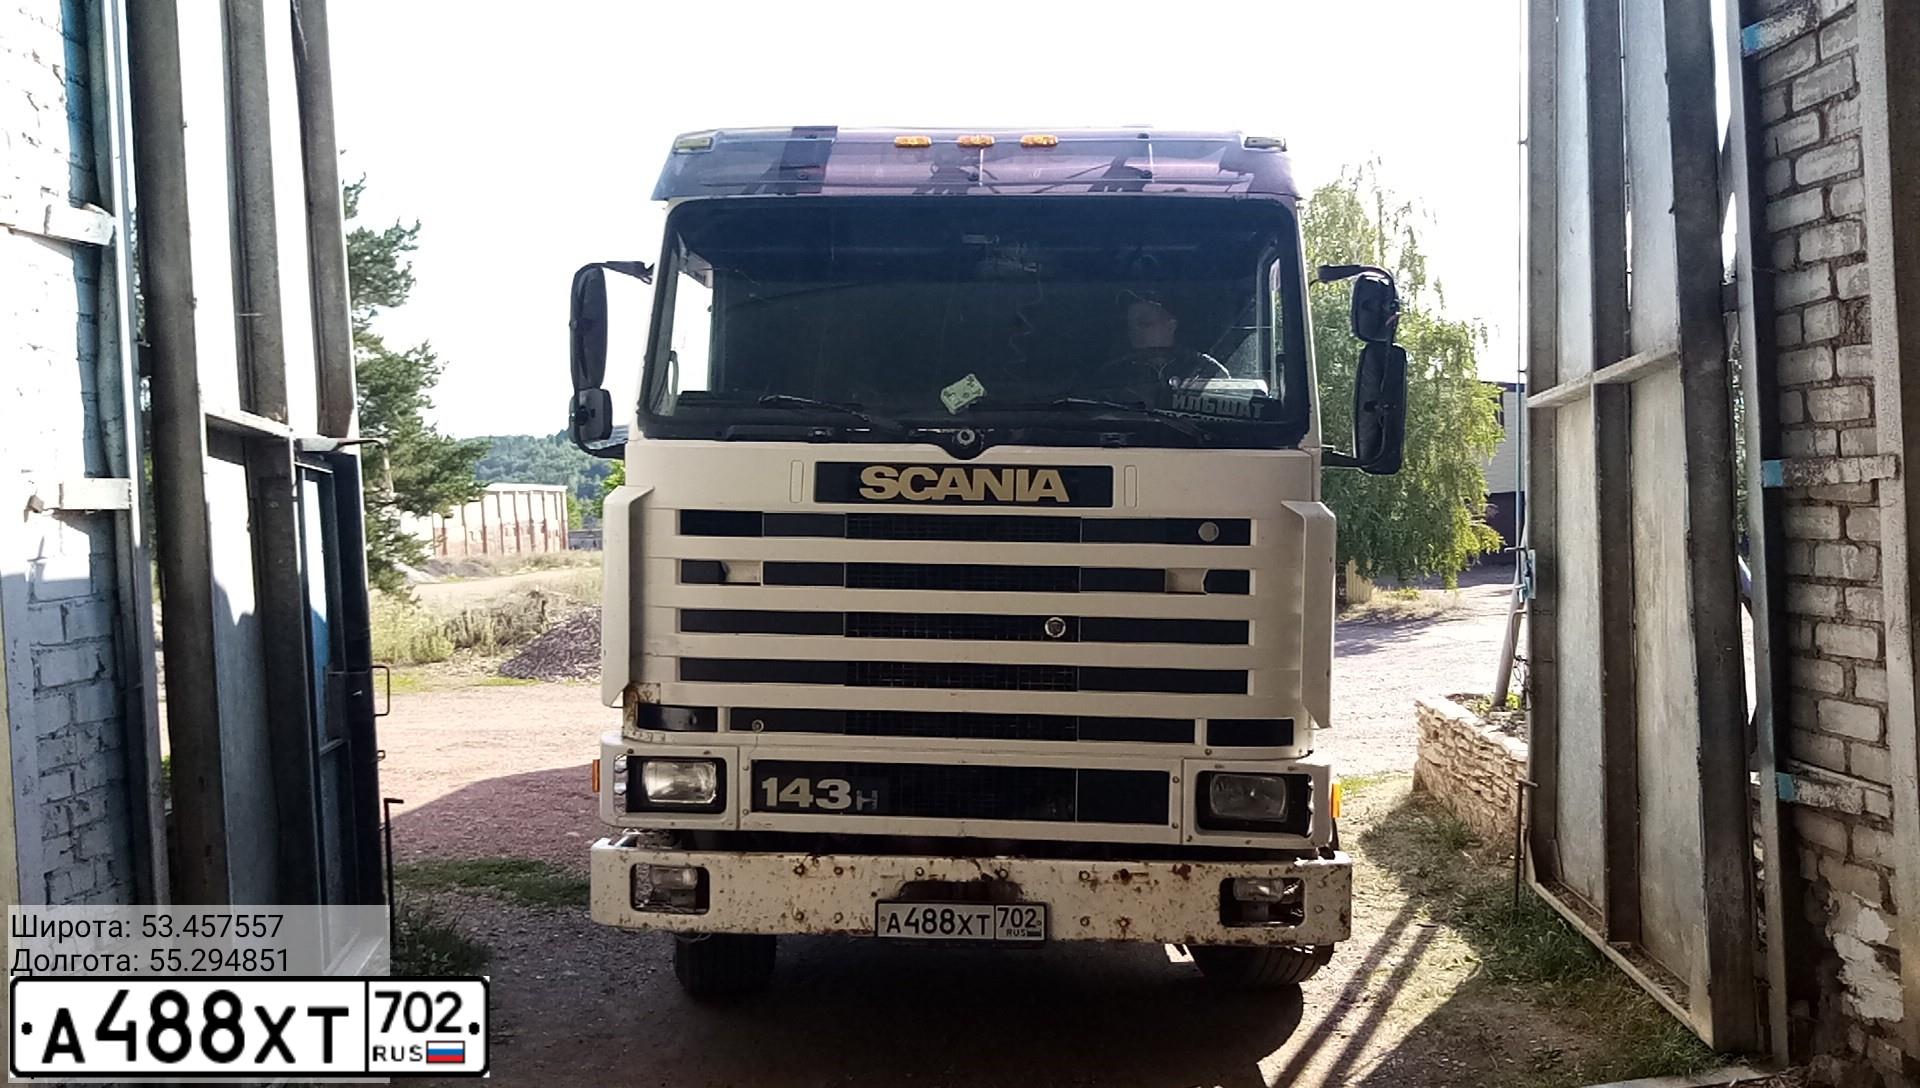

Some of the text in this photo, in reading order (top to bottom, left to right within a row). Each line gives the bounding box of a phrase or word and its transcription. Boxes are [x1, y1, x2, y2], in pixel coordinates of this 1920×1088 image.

[859, 465, 1070, 503] SCANIA
[886, 907, 1038, 936] А488ХТ 702
[1006, 929, 1026, 937] RUS
